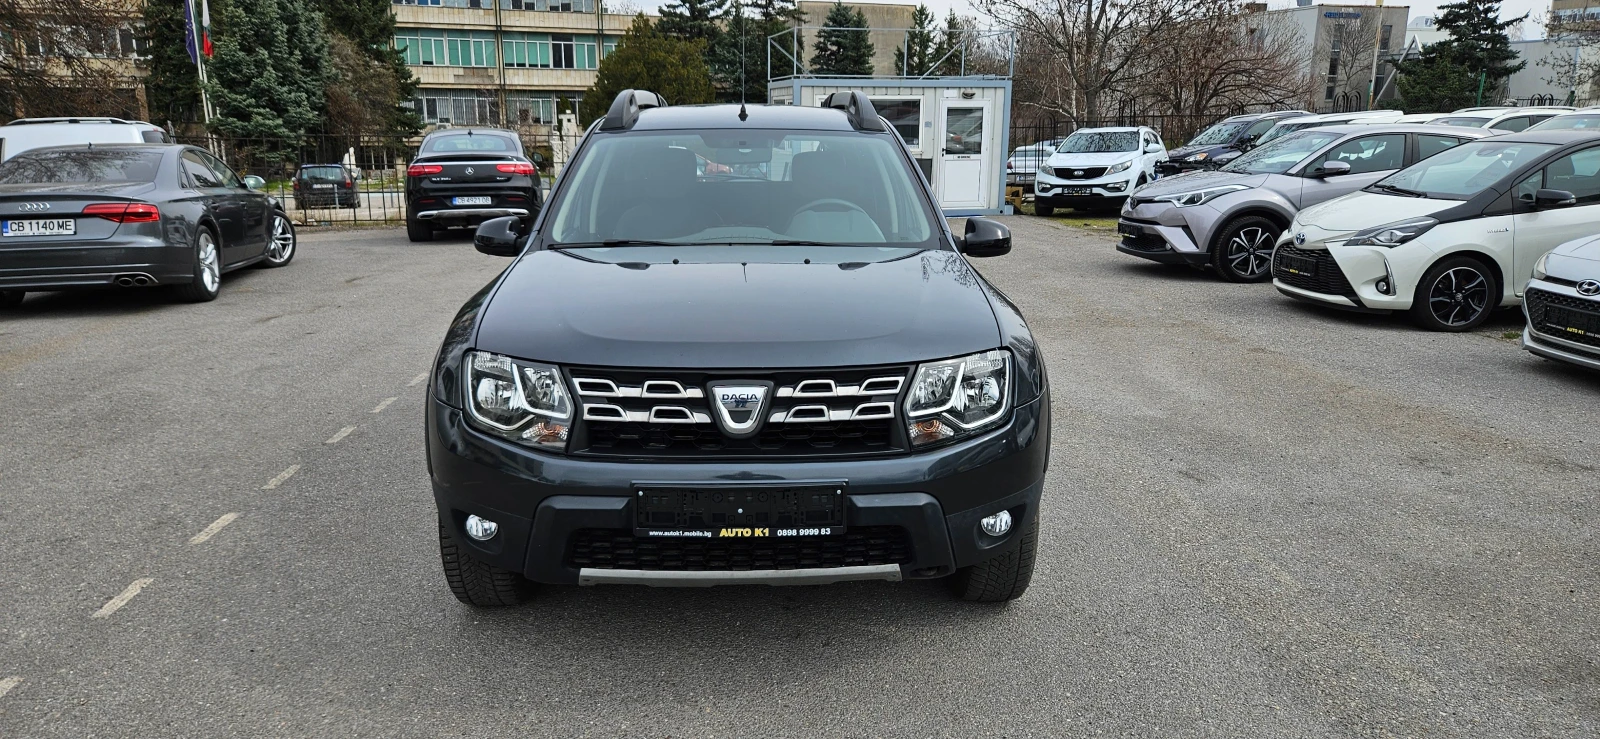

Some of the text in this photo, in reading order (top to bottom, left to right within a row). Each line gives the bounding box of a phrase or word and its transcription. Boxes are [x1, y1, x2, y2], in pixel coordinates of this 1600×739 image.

[10, 220, 72, 232] CB 1140 ME
[648, 527, 831, 538] www.autok1.mobile.bg AUTO K1 0898 9999 83
